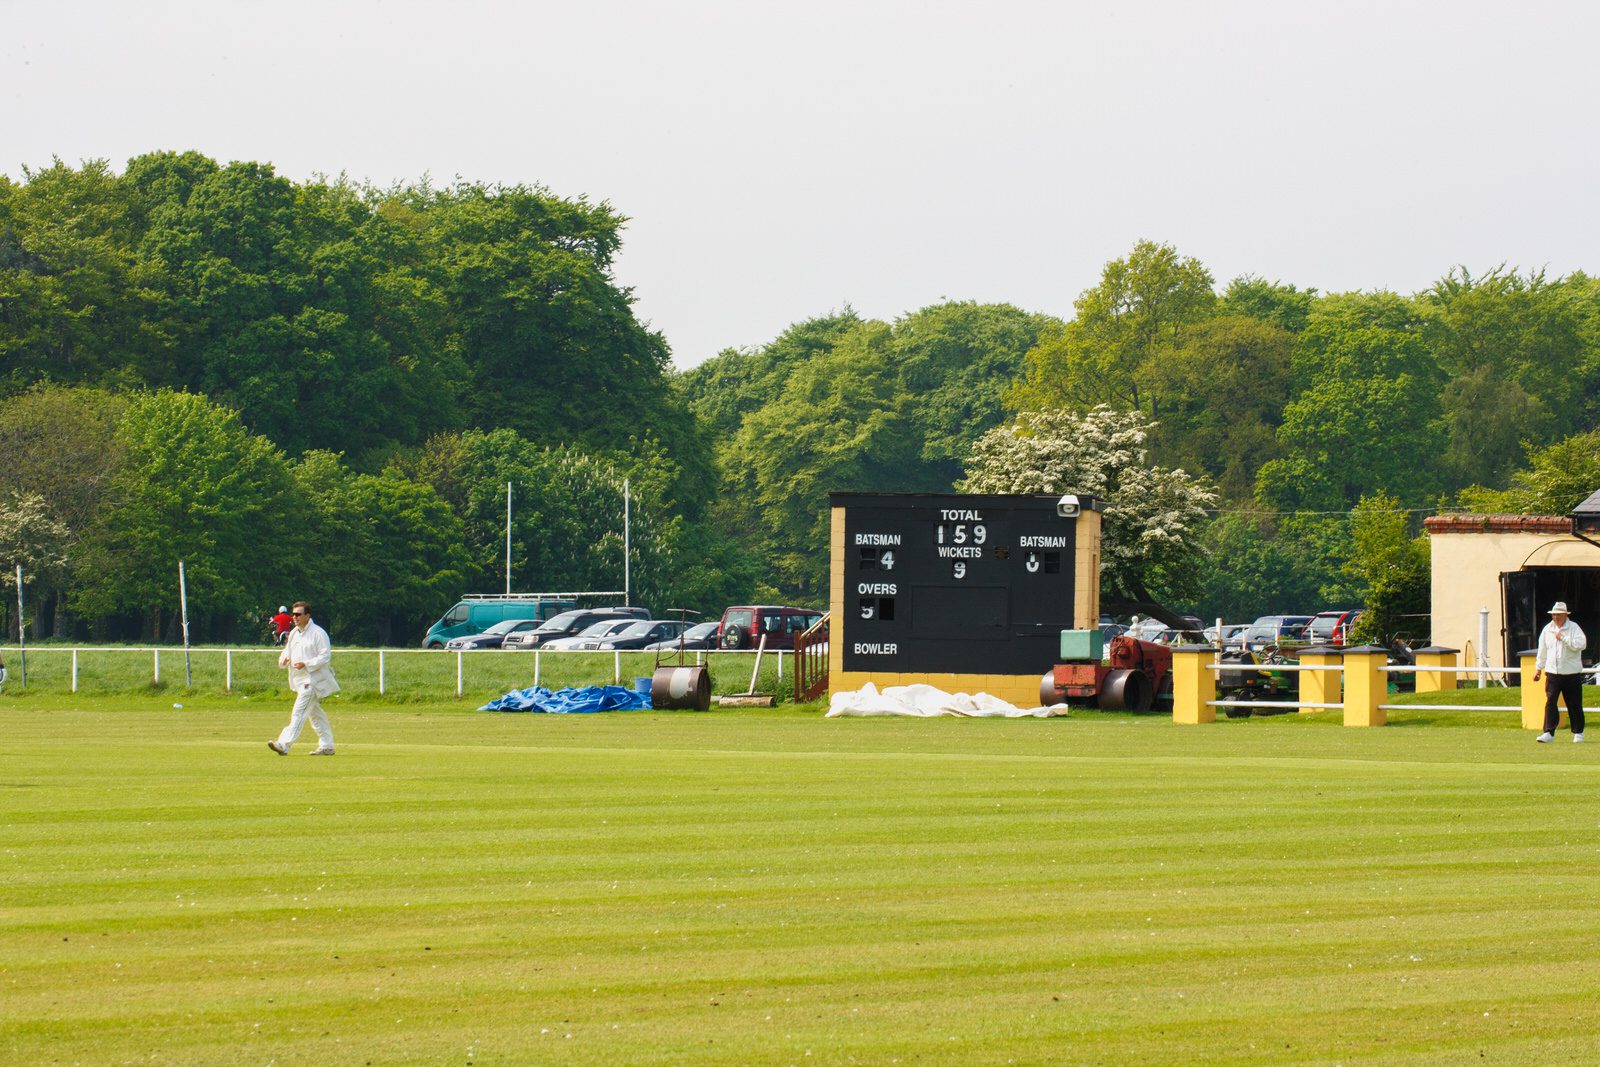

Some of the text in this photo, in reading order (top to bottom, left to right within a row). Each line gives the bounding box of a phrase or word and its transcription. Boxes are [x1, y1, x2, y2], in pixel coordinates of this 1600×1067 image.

[941, 509, 983, 521] TOTAL
[855, 534, 901, 546] BATSMAN
[1020, 536, 1066, 548] BATSMAN
[938, 546, 982, 558] WICKETS
[880, 550, 895, 570] 4
[858, 583, 897, 595] OVERS
[854, 643, 898, 655] BOWLER
